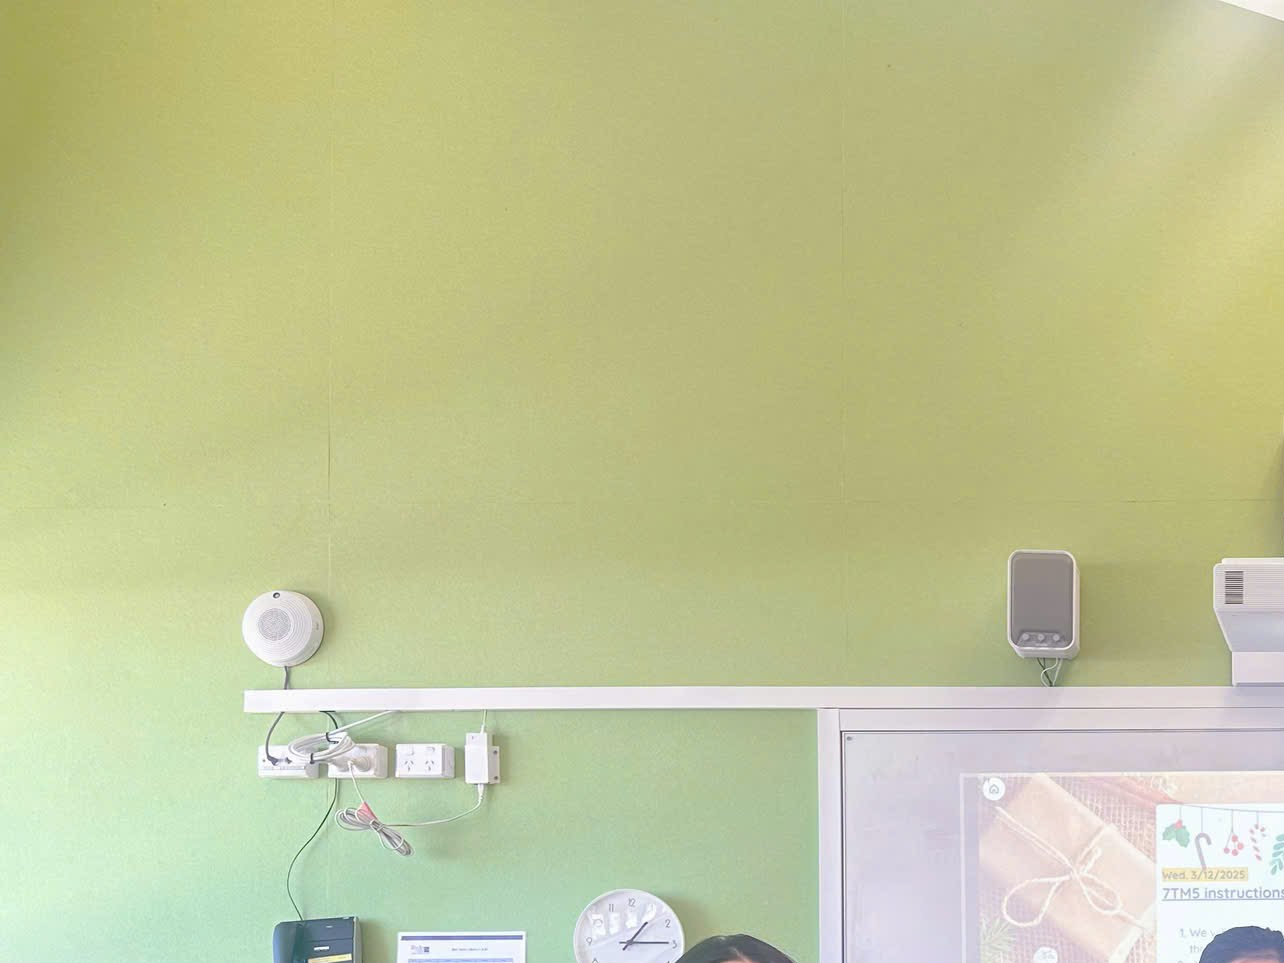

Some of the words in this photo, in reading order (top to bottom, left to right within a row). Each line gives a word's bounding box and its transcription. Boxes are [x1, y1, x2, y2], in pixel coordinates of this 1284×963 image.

[1191, 870, 1246, 881] 3/12/2025
[1162, 887, 1200, 899] 7TM5
[665, 918, 671, 928] 2
[1189, 928, 1207, 937] We
